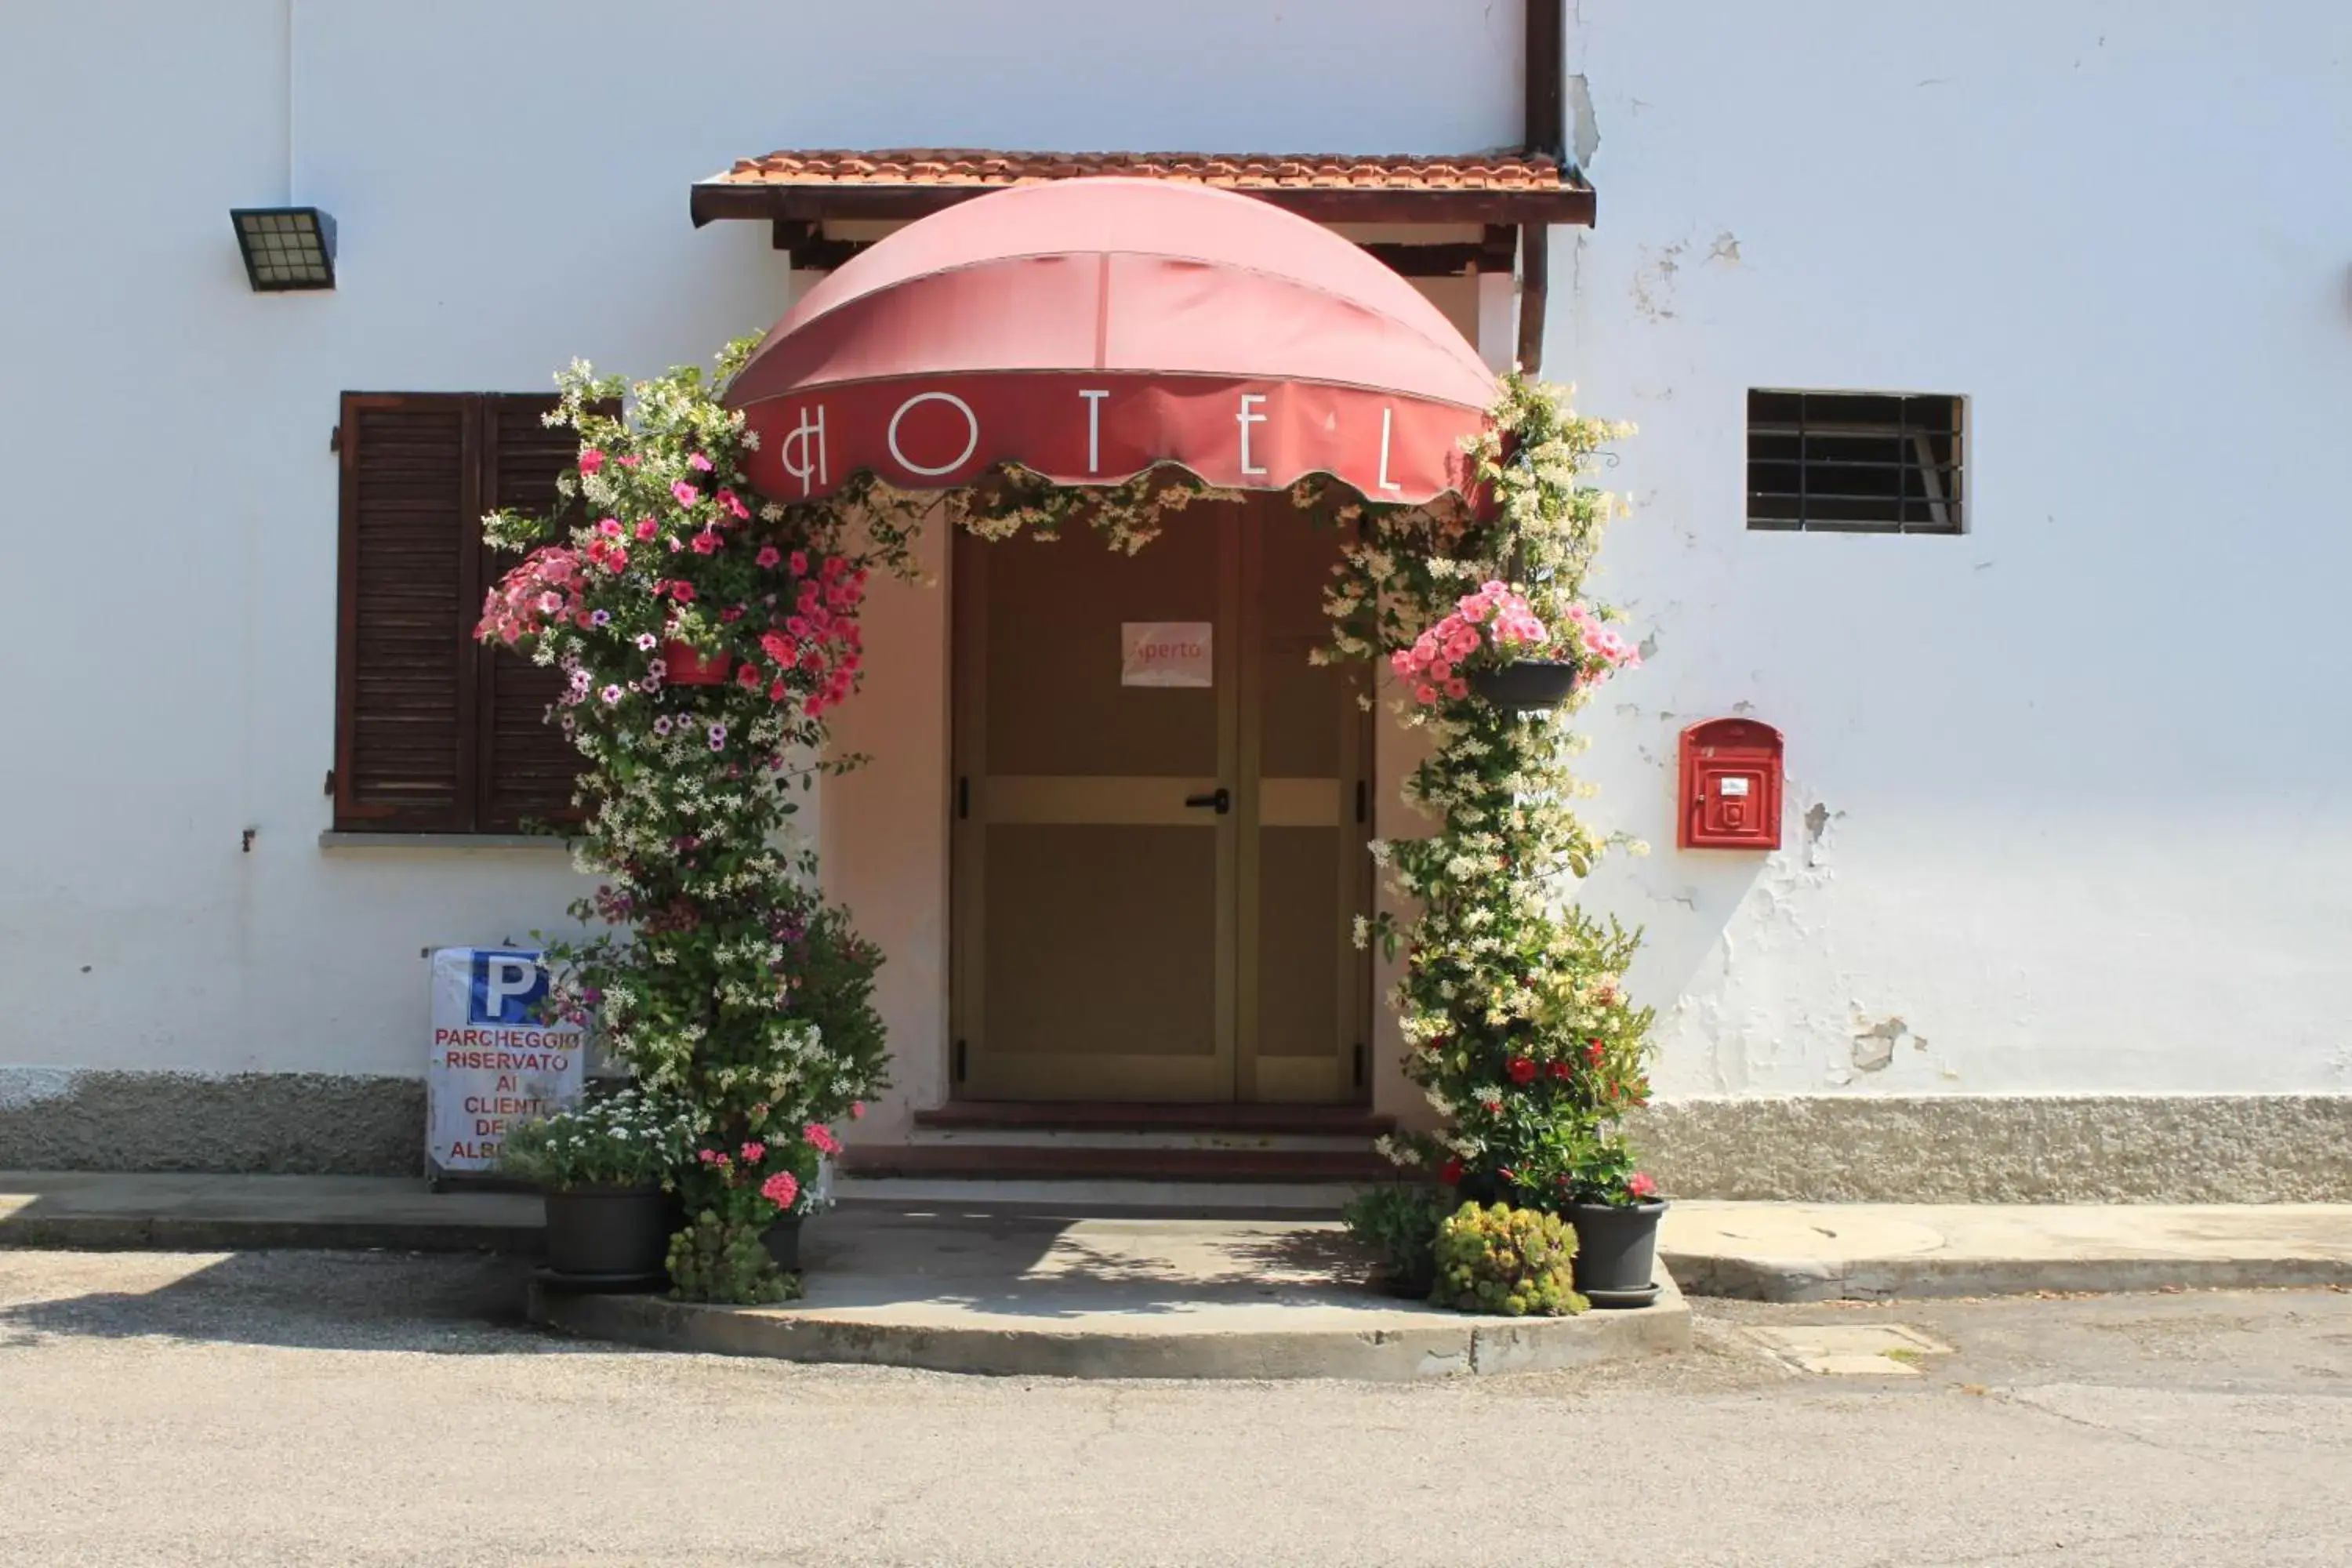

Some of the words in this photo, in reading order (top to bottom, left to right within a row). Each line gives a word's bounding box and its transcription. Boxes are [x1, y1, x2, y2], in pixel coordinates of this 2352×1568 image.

[782, 390, 1401, 497] HOTEL
[486, 955, 537, 1017] P
[435, 1029, 579, 1049] PARCHEGGIO
[446, 1051, 568, 1072] RISERVATO
[495, 1075, 517, 1092] AI
